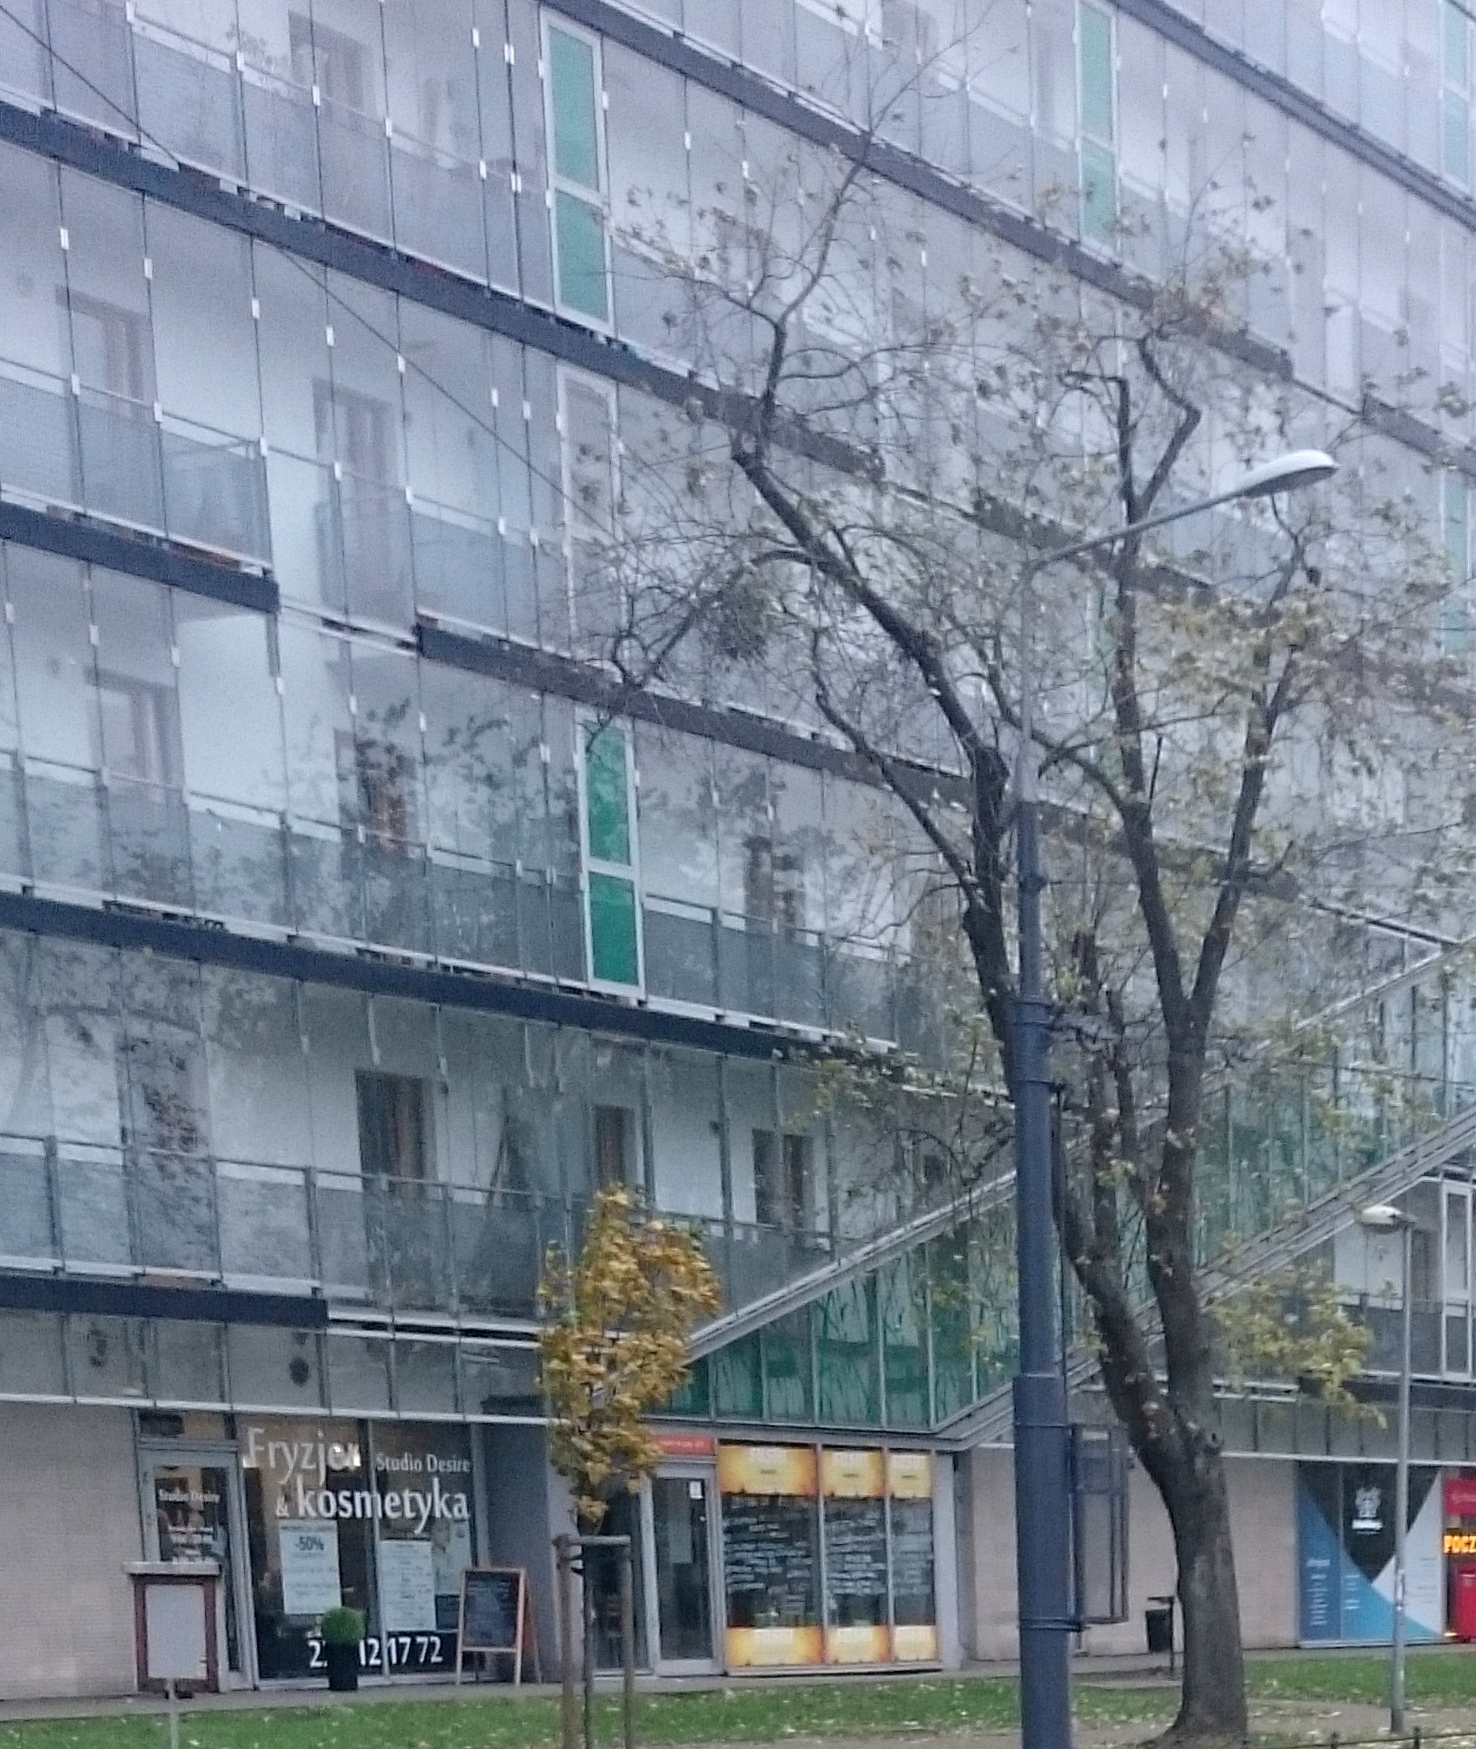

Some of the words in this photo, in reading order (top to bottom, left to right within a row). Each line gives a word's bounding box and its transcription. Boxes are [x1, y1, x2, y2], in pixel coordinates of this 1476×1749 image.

[247, 1427, 361, 1487] Fryzjer
[376, 1452, 422, 1472] Studio
[426, 1453, 471, 1473] Desire
[276, 1497, 290, 1518] &
[297, 1475, 469, 1534] kosmetyka
[294, 1535, 324, 1551] -50%
[308, 1638, 328, 1668] 2
[386, 1637, 411, 1665] 17
[416, 1636, 443, 1664] 72
